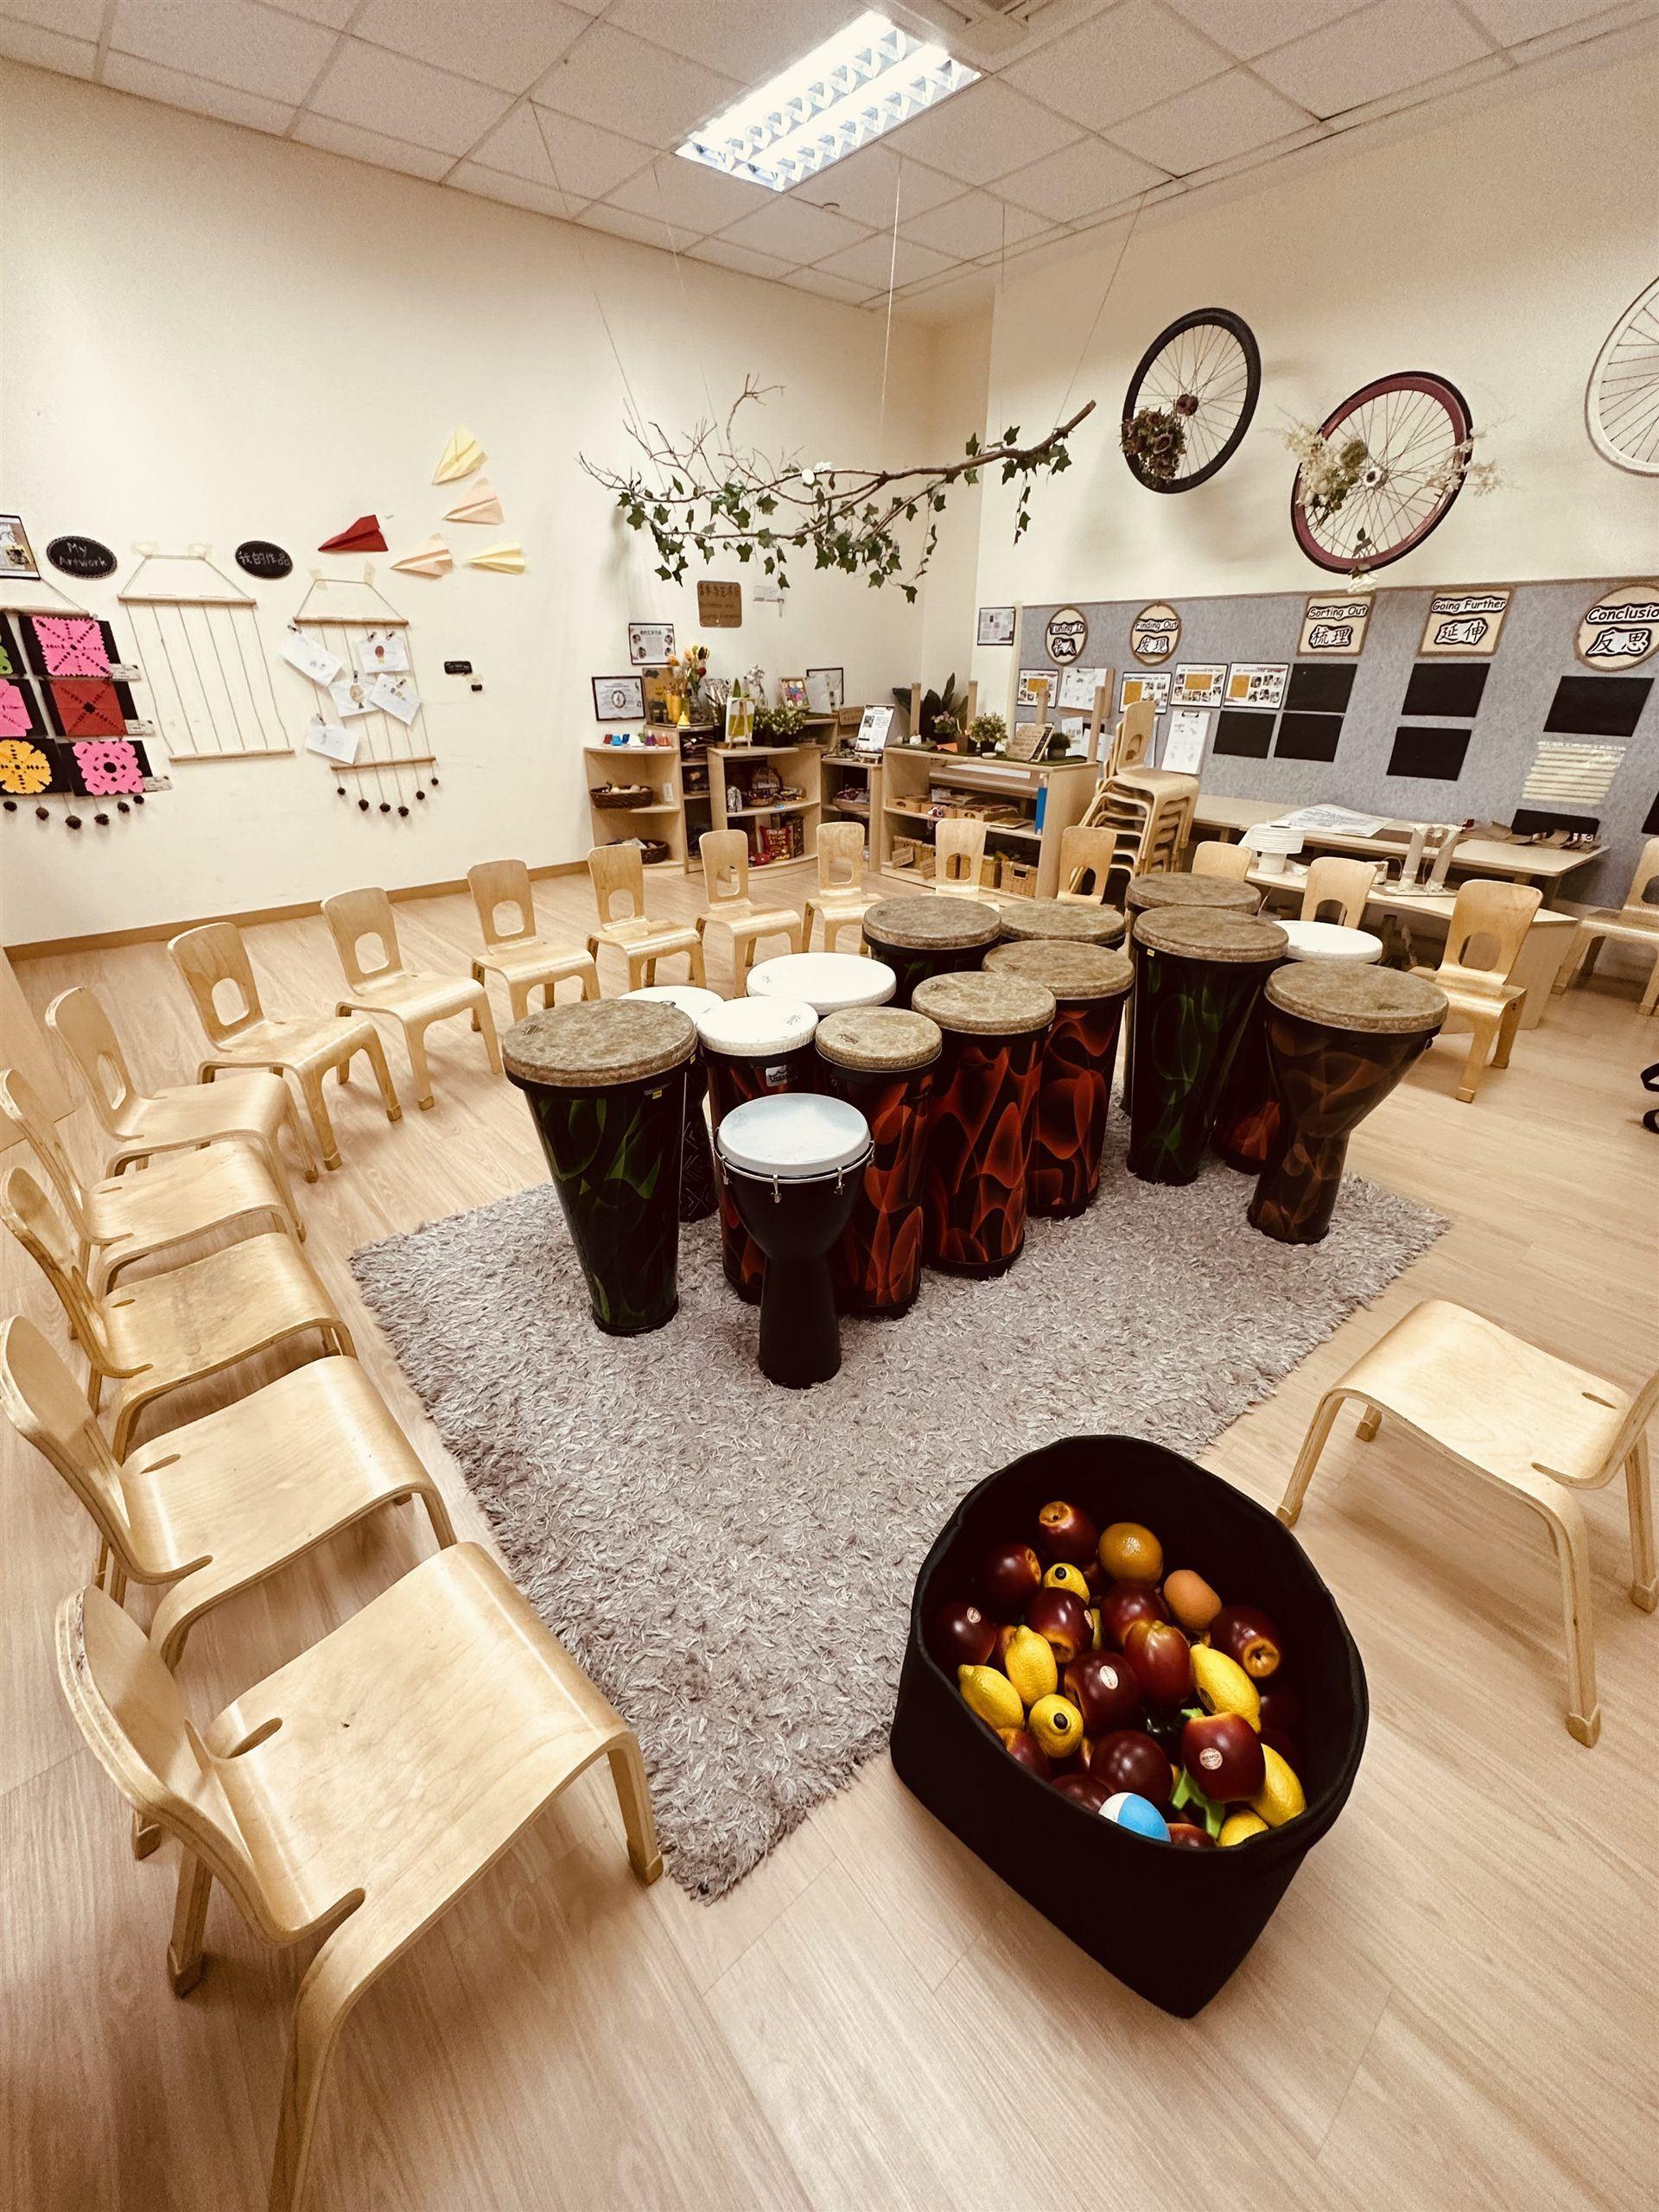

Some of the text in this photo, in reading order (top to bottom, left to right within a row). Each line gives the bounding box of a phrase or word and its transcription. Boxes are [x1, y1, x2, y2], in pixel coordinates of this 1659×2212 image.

[67, 542, 87, 558] My
[238, 550, 290, 566] 我的作品
[59, 556, 108, 567] Artwork
[1309, 606, 1367, 619] Sorting Out
[1432, 597, 1506, 613] Going Further
[1052, 624, 1072, 634] Tuning
[1135, 620, 1178, 632] Finding Out
[1438, 621, 1485, 643] 延伸
[1312, 627, 1351, 645] 梳理
[1591, 631, 1647, 653] 反思
[1052, 639, 1076, 656] 导入
[1139, 637, 1167, 653] 发现
